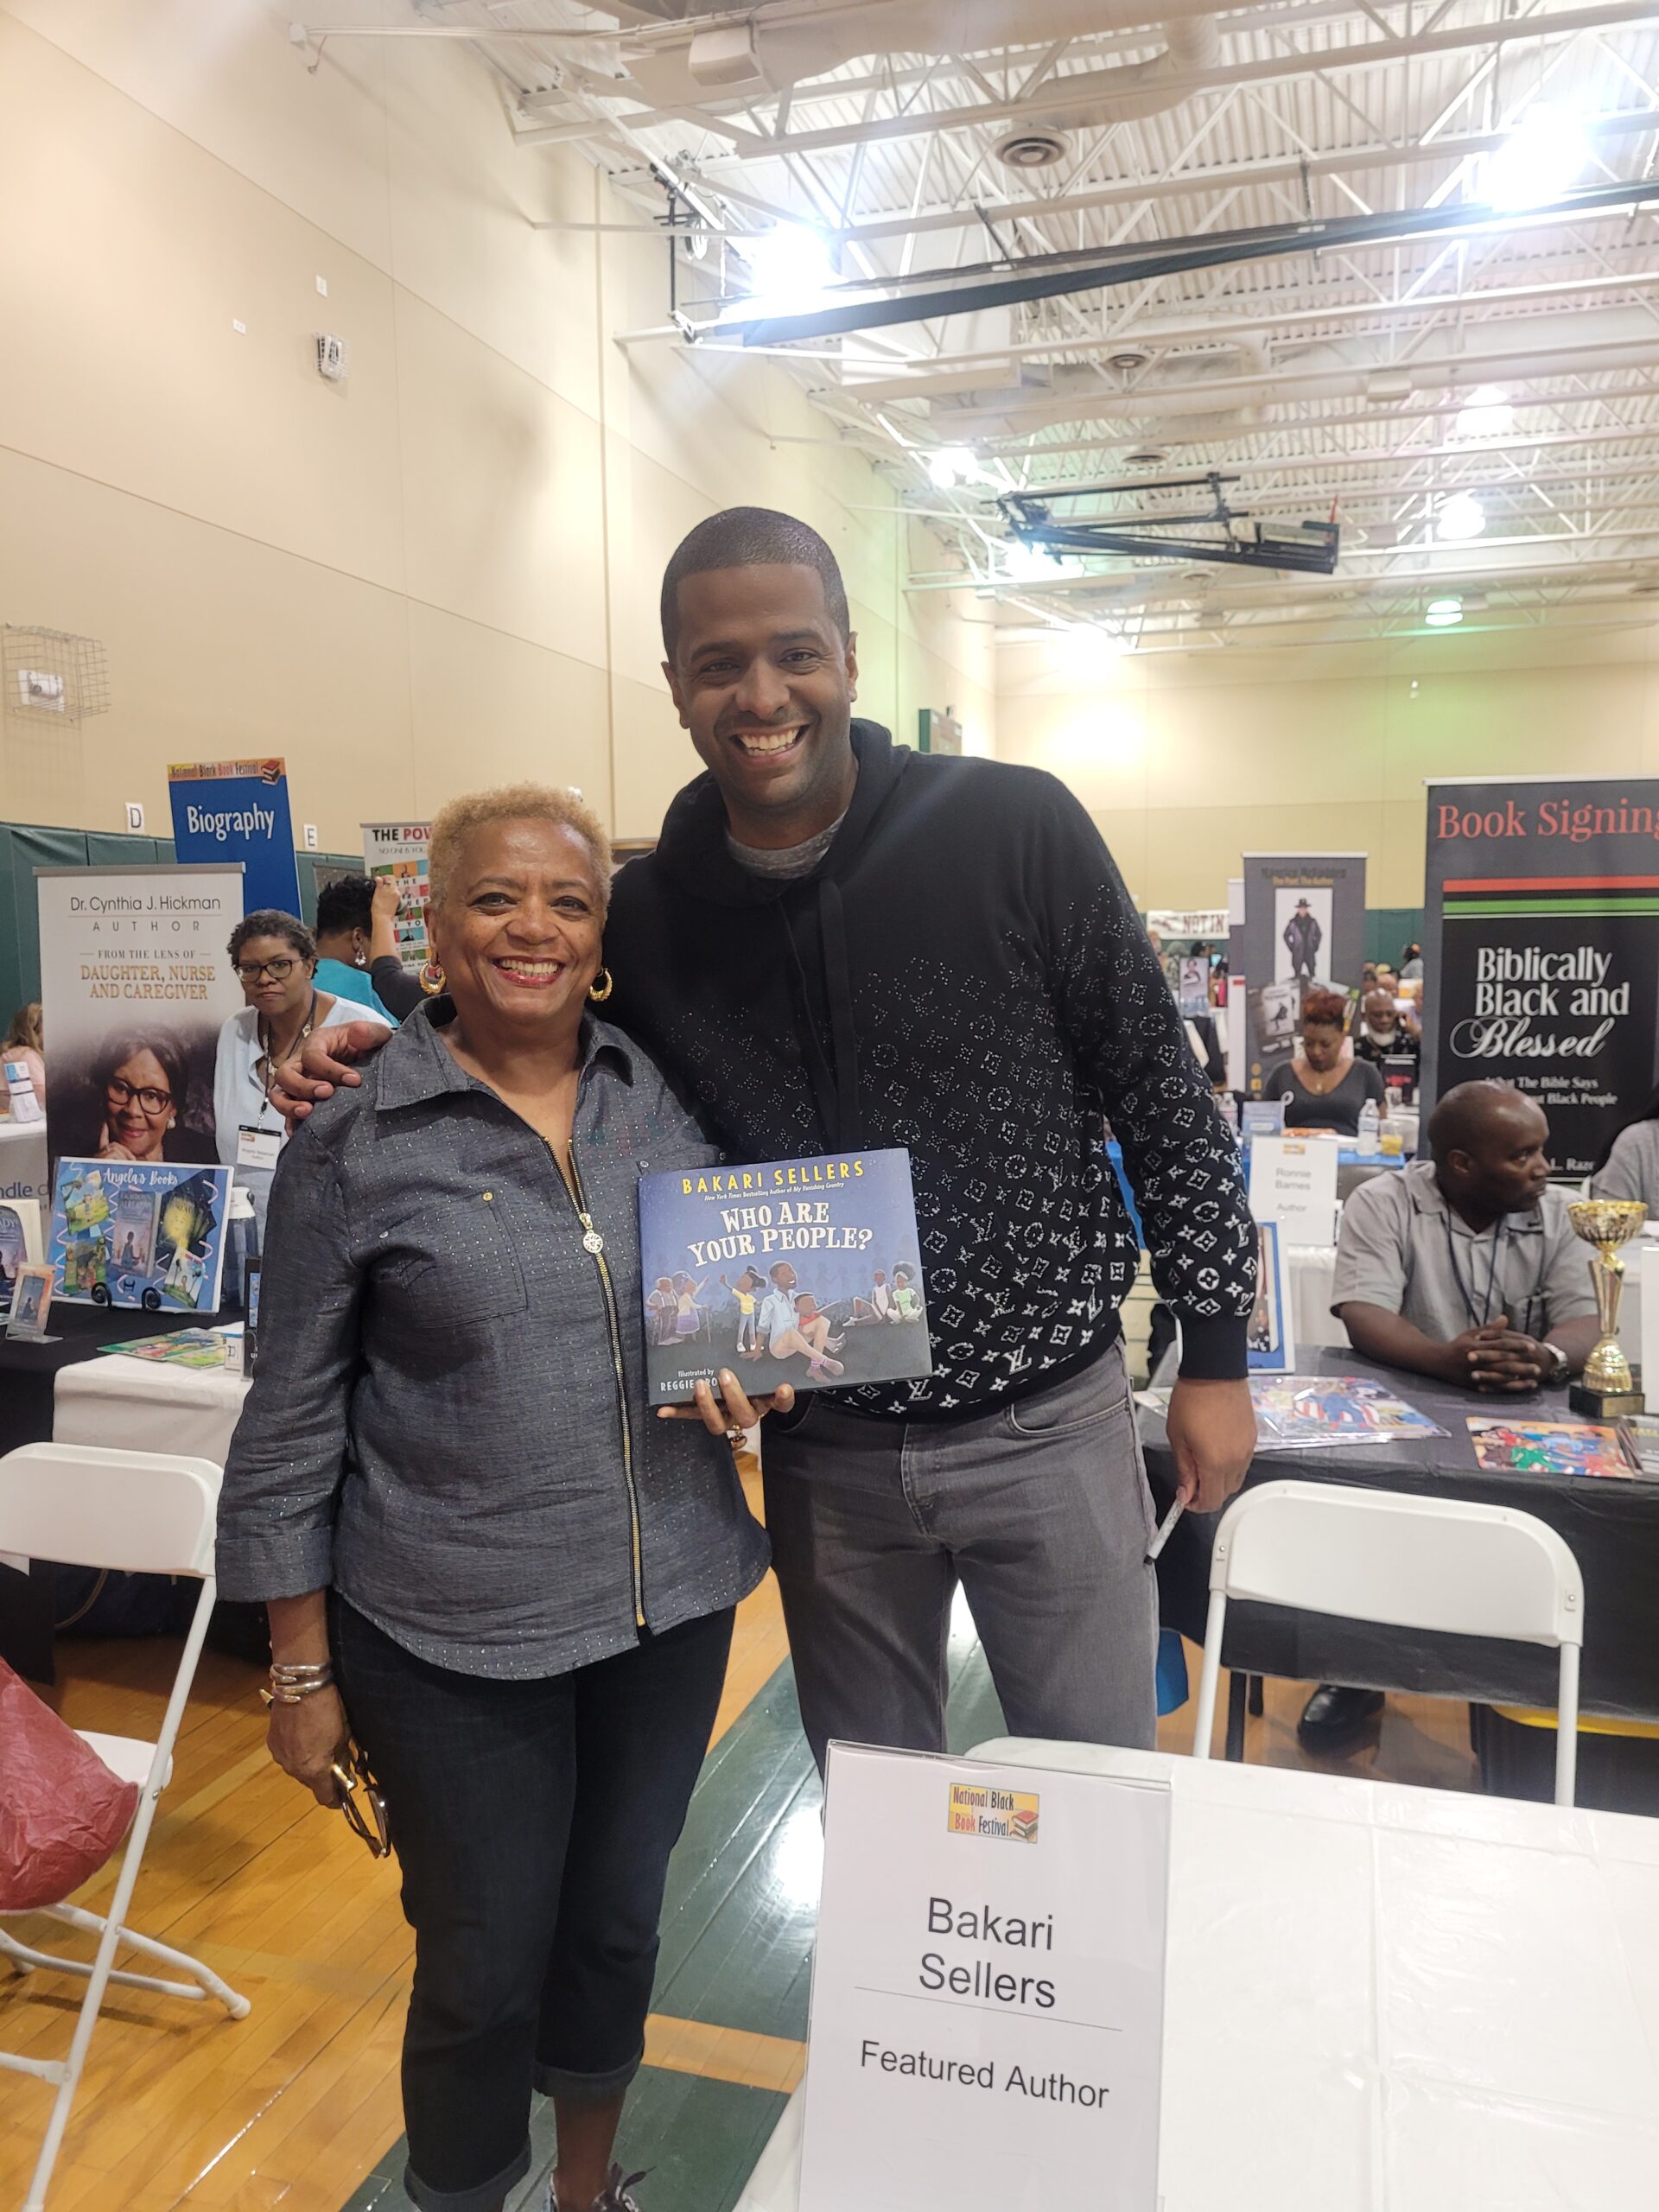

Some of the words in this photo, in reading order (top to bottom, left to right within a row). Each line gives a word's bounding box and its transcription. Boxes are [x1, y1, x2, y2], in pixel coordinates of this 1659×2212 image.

[130, 807, 142, 829] D
[187, 803, 275, 842] Biography
[1437, 800, 1527, 839] Book
[307, 828, 315, 847] E
[372, 829, 399, 842] THE
[71, 897, 87, 911] Dr.
[90, 896, 142, 913] Cynthia
[147, 896, 157, 910] J.
[160, 896, 220, 910] Hickman
[92, 921, 200, 931] AUTHOR
[98, 950, 125, 959] FROM
[130, 950, 149, 959] THE
[154, 950, 180, 959] LENS
[183, 950, 196, 958] OF
[80, 965, 165, 982] DAUGHTER,
[168, 965, 215, 981] NURSE
[1477, 946, 1612, 987] Biblically
[90, 983, 120, 998] AND
[124, 983, 208, 1000] CAREGIVER
[1474, 982, 1559, 1016] Black
[1569, 982, 1630, 1016] and
[1450, 1016, 1615, 1058] Blessed
[1516, 1076, 1540, 1089] The
[1541, 1076, 1571, 1089] Bible
[1572, 1076, 1599, 1090] Says
[1547, 1092, 1580, 1105] Black
[1580, 1092, 1619, 1108] People
[103, 1167, 146, 1186] Angela's
[149, 1170, 178, 1186] Books
[682, 1172, 763, 1195] BAKARI
[773, 1160, 864, 1186] SELLERS
[1275, 1167, 1312, 1178] Ronnie
[742, 1190, 769, 1198] Bestselling
[769, 1187, 786, 1196] Author
[793, 1185, 802, 1194] My
[802, 1183, 825, 1192] Vanishing
[825, 1181, 845, 1190] Country
[1275, 1179, 1311, 1190] Barnes
[721, 1205, 772, 1234] WHO
[778, 1201, 830, 1226] ARE
[687, 1234, 756, 1268] YOUR
[760, 1227, 873, 1253] PEOPLE?
[677, 1369, 707, 1378] Illustrated
[707, 1368, 715, 1376] by
[660, 1379, 694, 1392] REGGIE
[953, 1786, 988, 1808] National
[990, 1791, 1014, 1811] Black
[955, 1813, 976, 1832] Book
[978, 1815, 1009, 1837] Festival
[927, 1897, 1053, 1950] Bakari
[919, 1953, 1056, 2009] Sellers
[861, 2039, 995, 2089] Featured
[1005, 2064, 1109, 2109] Author
